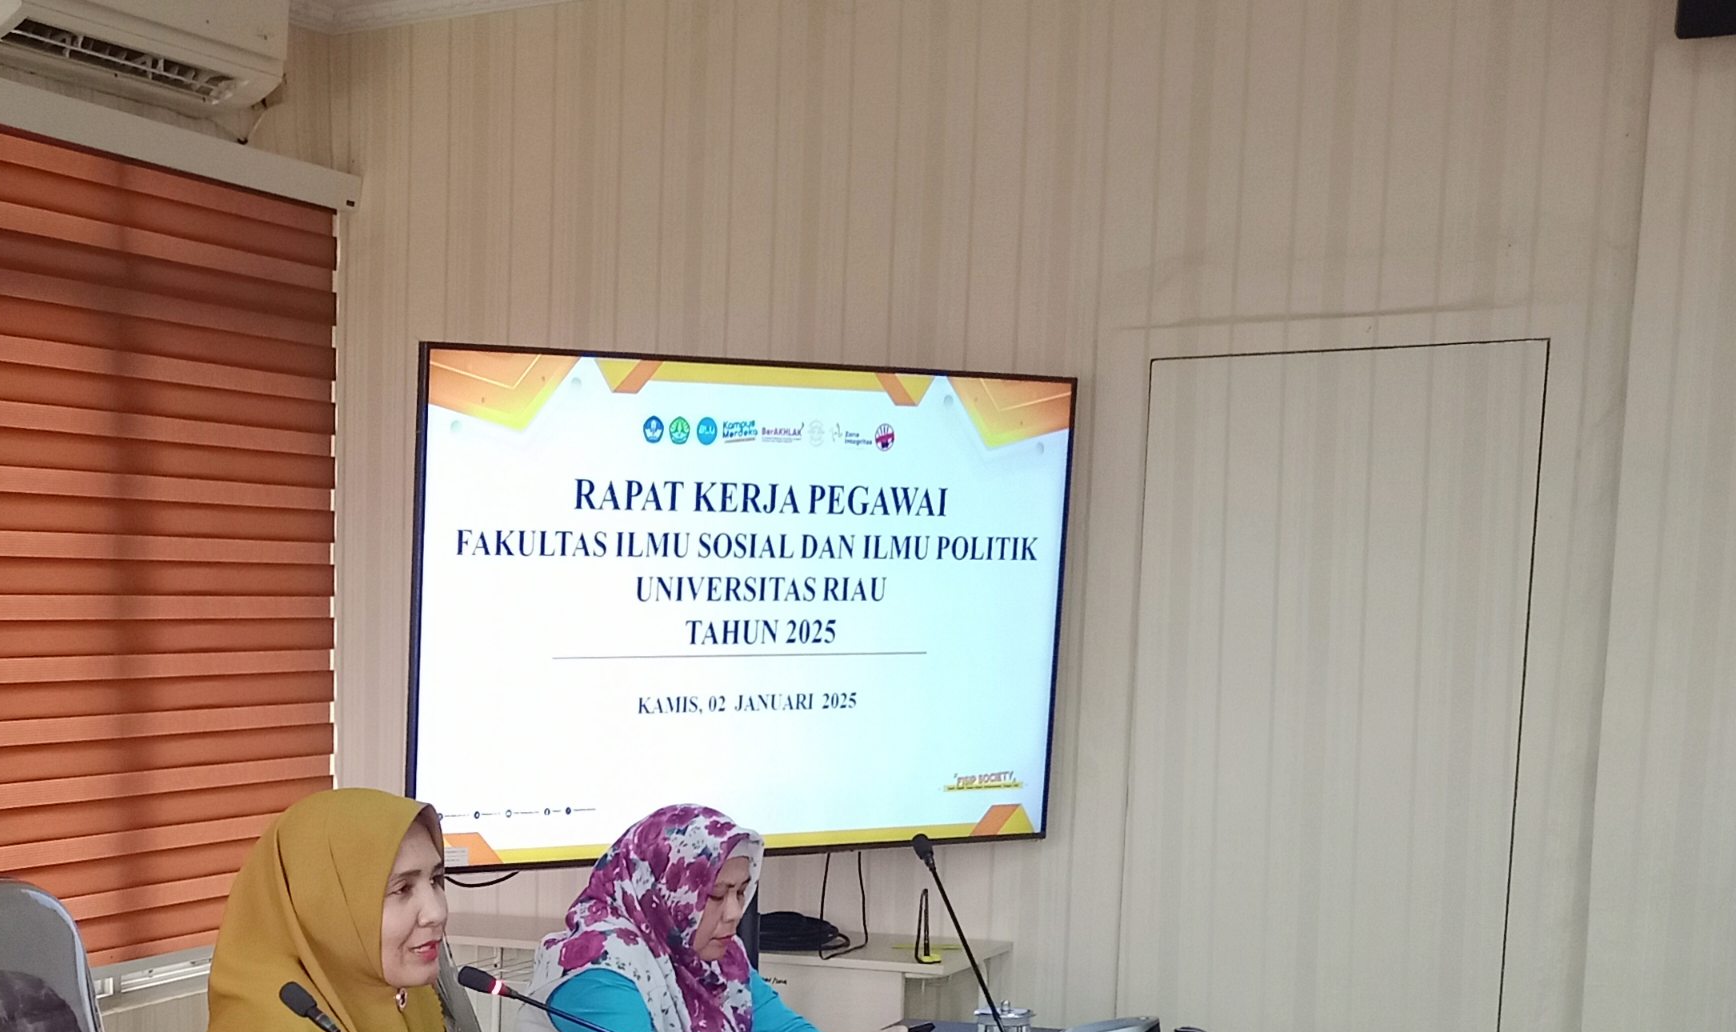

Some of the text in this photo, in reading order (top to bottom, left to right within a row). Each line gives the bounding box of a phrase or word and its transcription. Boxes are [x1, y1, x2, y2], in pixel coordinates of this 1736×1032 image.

[574, 478, 948, 517] RAPAT KERJA PEGAWAI
[456, 529, 1038, 561] FAKULTAS ILMU SOSIAL DAN ILMU POLITIK
[636, 576, 887, 602] UNIVERSITAS RIAU
[685, 619, 837, 645] TAHUN 2025
[637, 691, 857, 715] KAMIS, 02 JANUARI 2025
